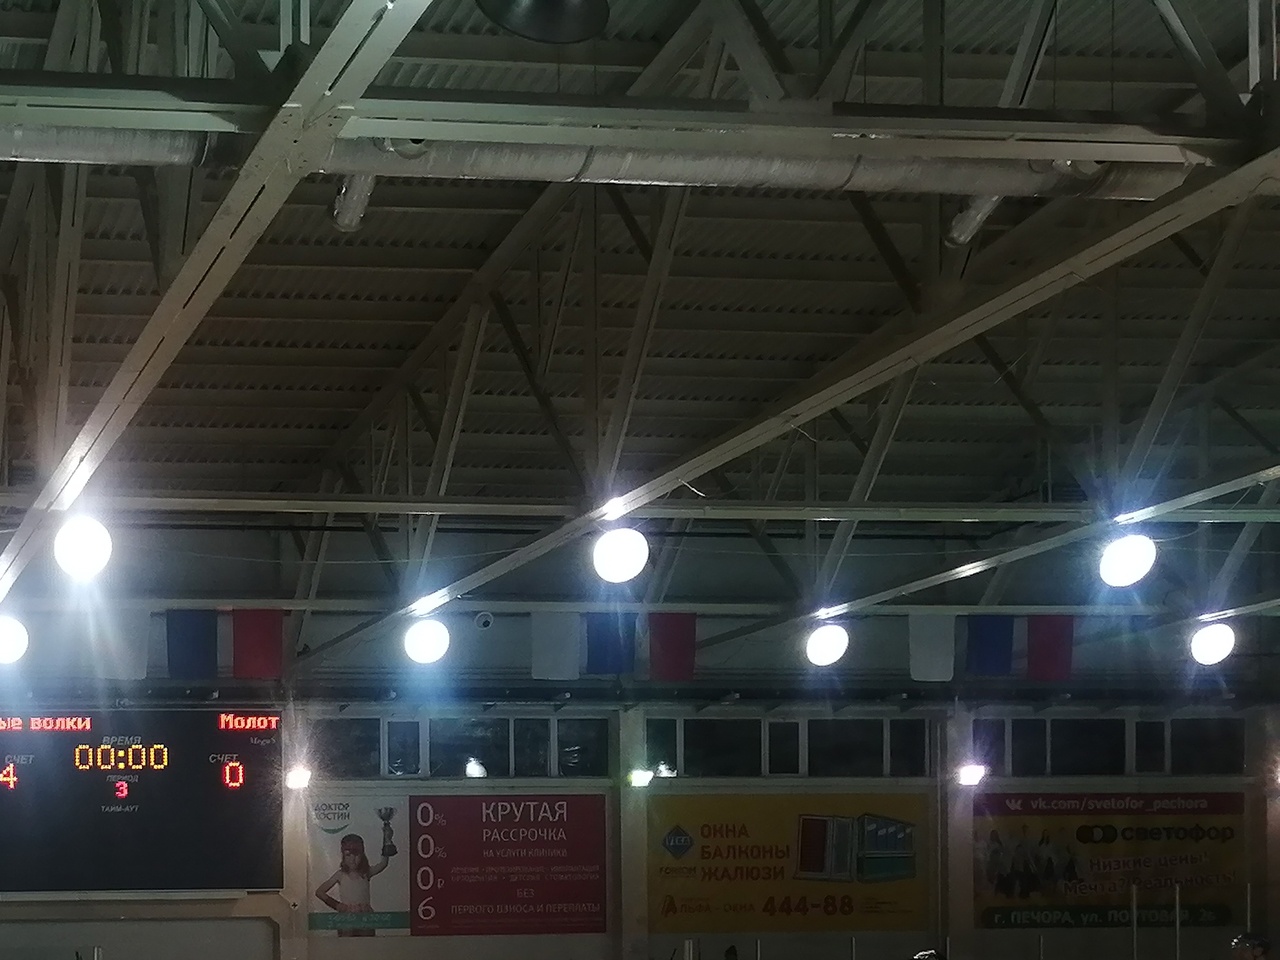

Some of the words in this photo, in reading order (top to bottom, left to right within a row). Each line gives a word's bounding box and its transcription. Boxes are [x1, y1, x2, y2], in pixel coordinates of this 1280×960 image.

[30, 716, 92, 731] волки
[220, 713, 280, 731] Молот
[102, 736, 141, 746] ВРЕМЯ
[74, 744, 169, 770] 00:00
[224, 761, 244, 787] 0
[114, 781, 129, 798] 3
[481, 801, 568, 823] КРУТАЯ
[483, 828, 567, 842] РАССРОЧКА
[700, 823, 750, 839] ОКНА
[1120, 823, 1235, 844] светофор
[700, 844, 790, 860] БАЛКОНЫ
[700, 866, 786, 882] ЖАЛЮЗИ
[516, 888, 535, 898] БЕЗ
[417, 895, 436, 921] 6
[761, 894, 855, 916] 444-88
